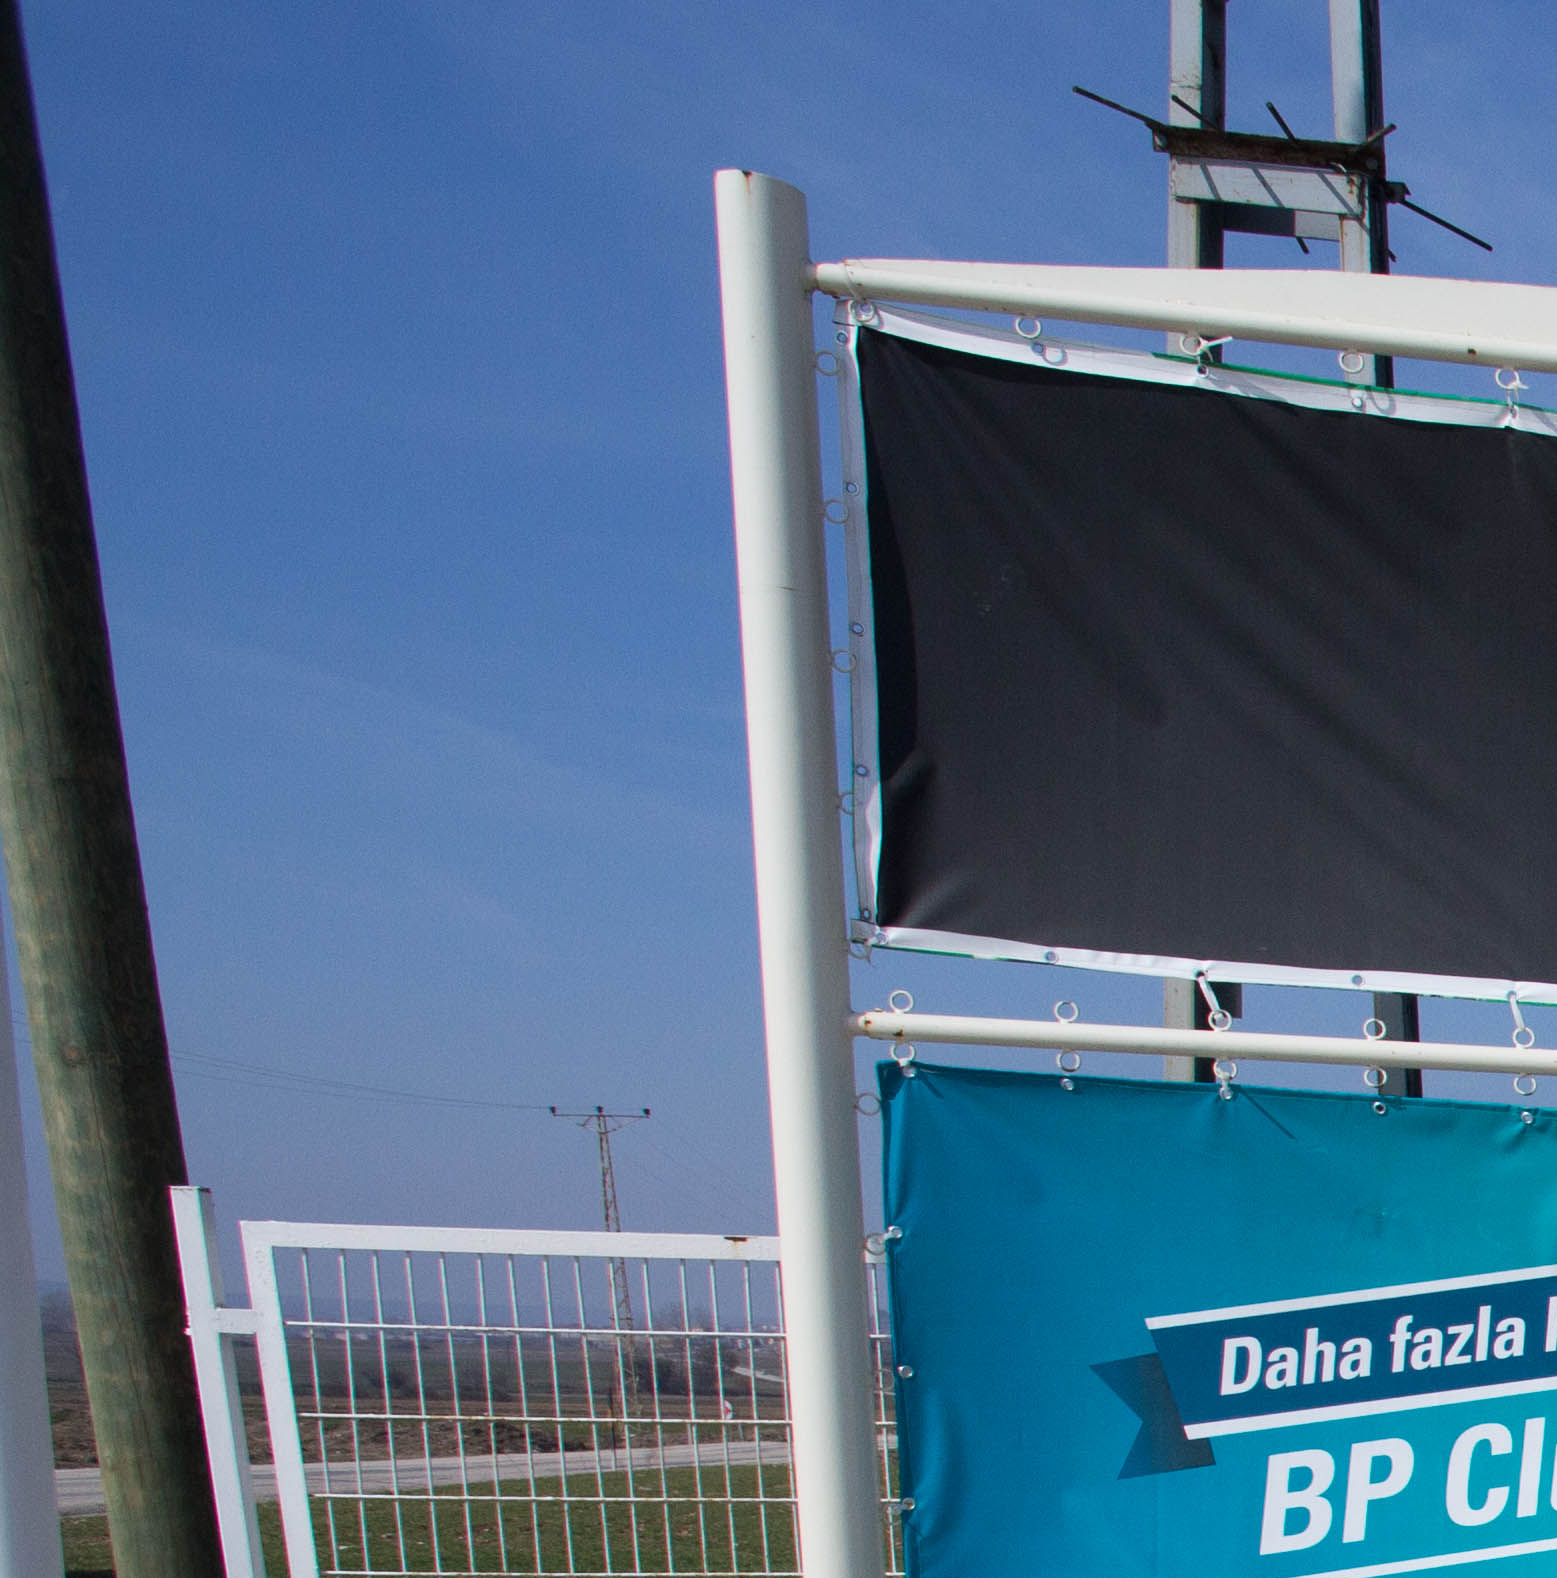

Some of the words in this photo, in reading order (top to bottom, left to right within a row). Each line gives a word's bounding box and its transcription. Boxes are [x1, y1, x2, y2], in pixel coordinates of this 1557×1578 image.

[1219, 1327, 1373, 1397] Daha
[1389, 1304, 1526, 1373] fazla
[1259, 1437, 1414, 1556] BP
